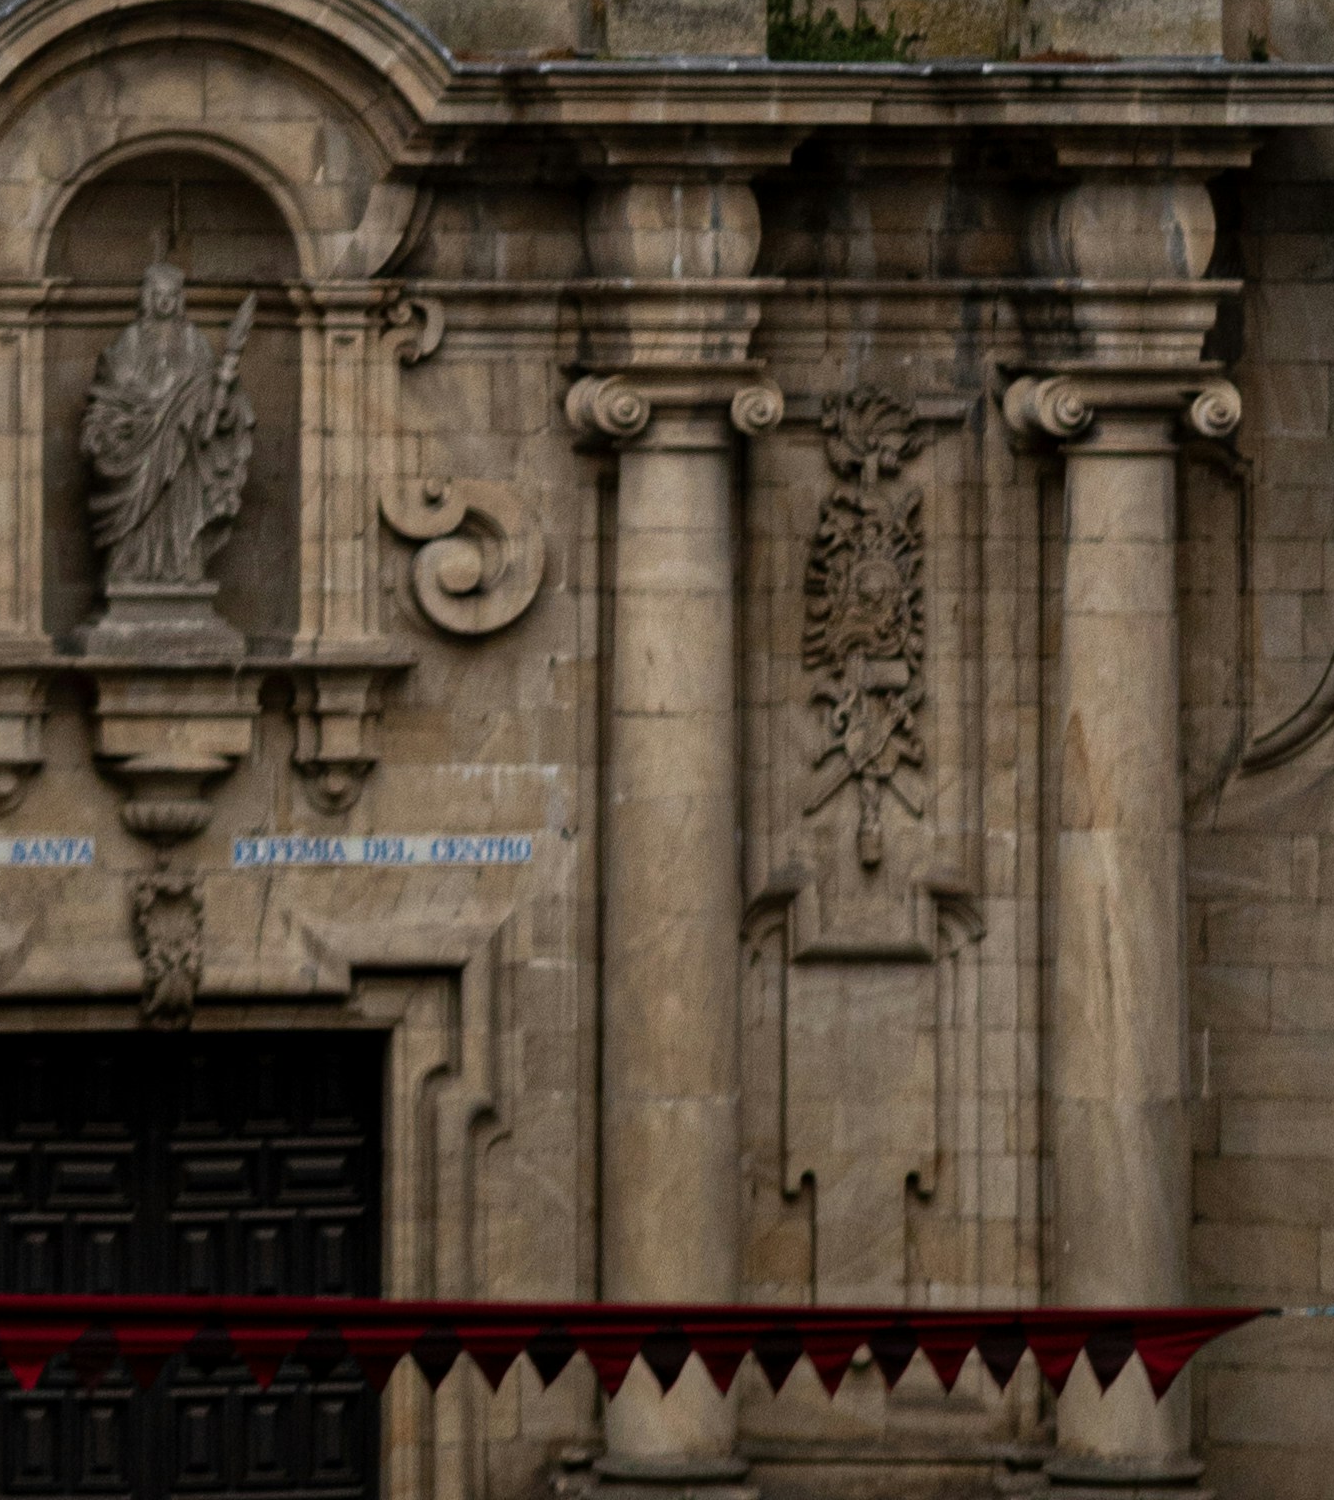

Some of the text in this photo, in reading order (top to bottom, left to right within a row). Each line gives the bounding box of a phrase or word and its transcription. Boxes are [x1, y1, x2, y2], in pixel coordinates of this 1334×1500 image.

[11, 838, 93, 864] SANTA
[234, 838, 346, 864] EUFEMIA
[431, 836, 532, 862] CENTRO
